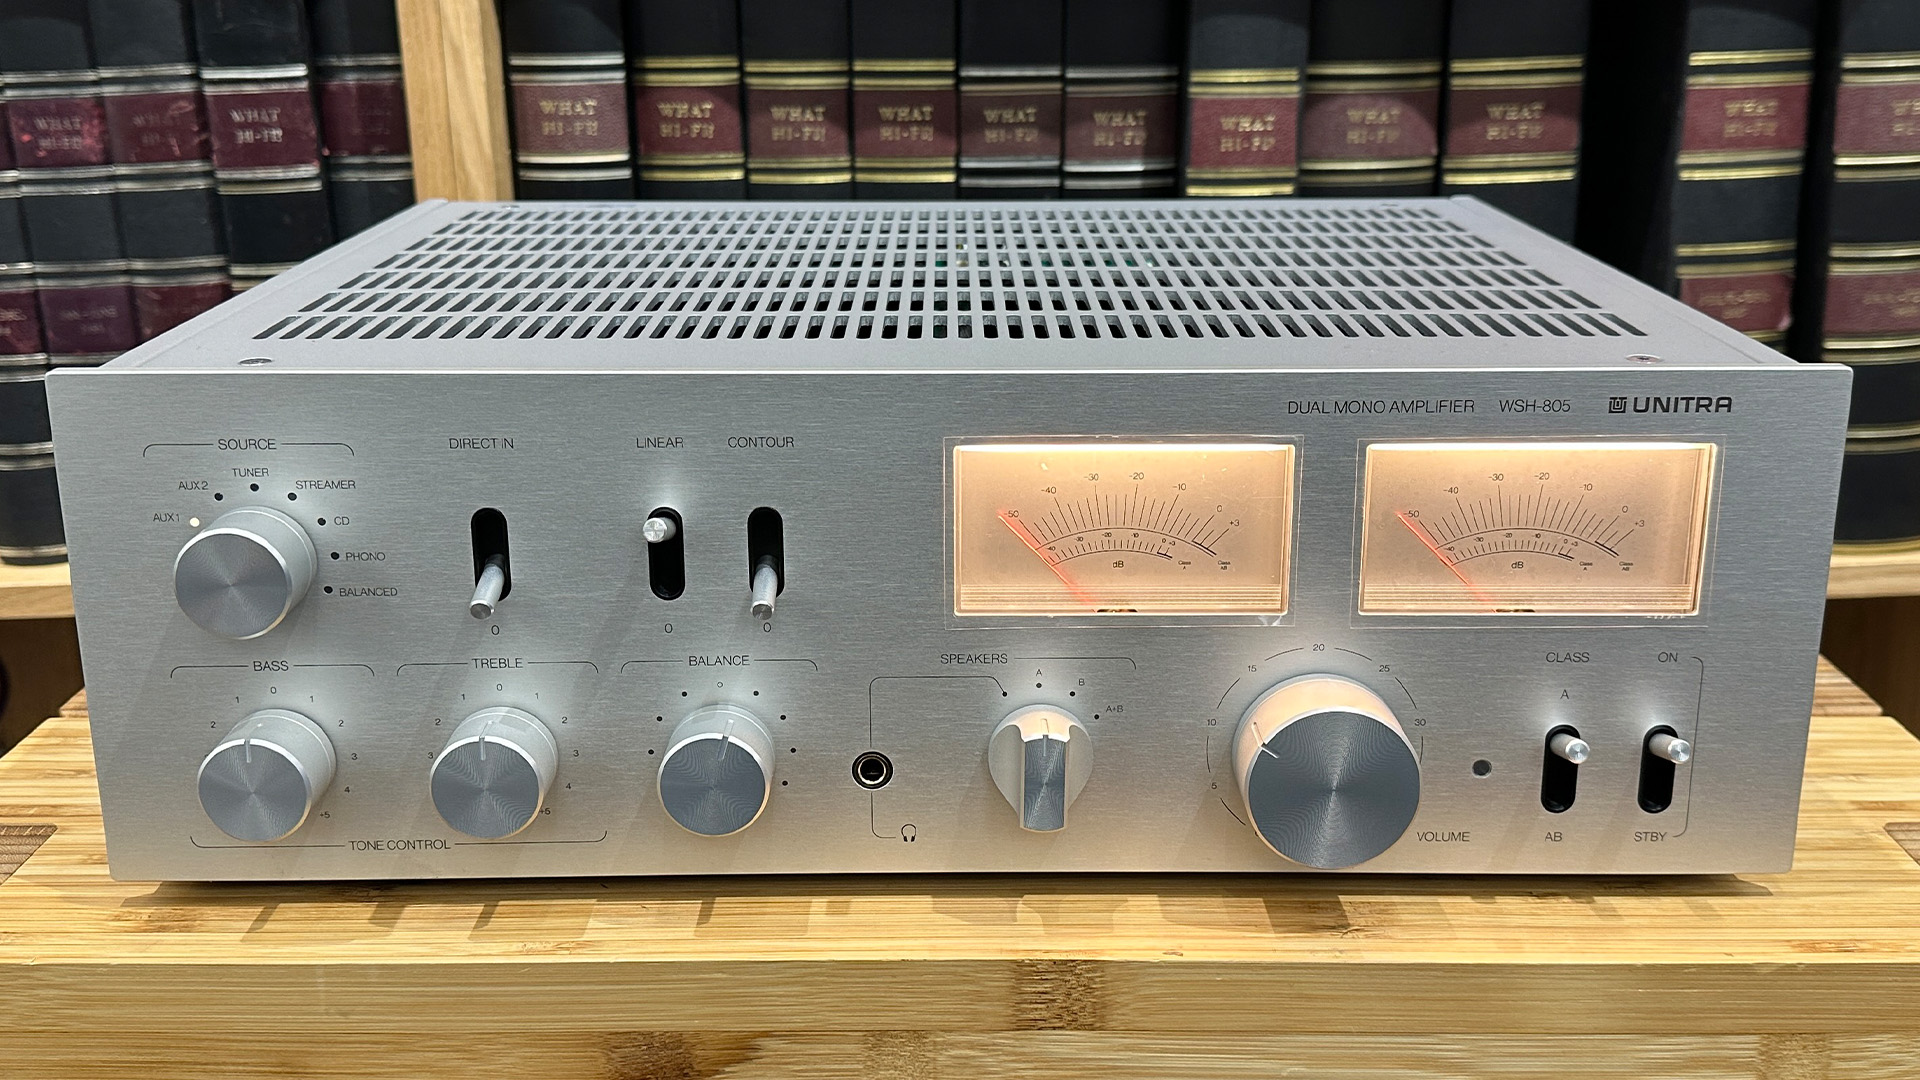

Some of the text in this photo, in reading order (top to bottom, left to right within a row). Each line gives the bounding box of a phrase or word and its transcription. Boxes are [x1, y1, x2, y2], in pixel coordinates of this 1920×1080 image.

[1288, 399, 1475, 415] DUAL MONO AMPLIFIER
[1499, 398, 1571, 413] WSH-805
[1632, 396, 1733, 414] UNITRA
[217, 438, 278, 451] SOURCE
[449, 437, 515, 450] DIRECT IN
[636, 437, 684, 450] LINEAR
[727, 436, 795, 450] CONTOUR
[232, 467, 270, 479] TUNER
[1084, 473, 1099, 482] -30
[1128, 472, 1145, 482] -20
[1487, 472, 1505, 483] -30
[1533, 471, 1550, 482] -20
[295, 480, 357, 491] STREAMER
[1172, 482, 1188, 493] -10
[1442, 485, 1460, 496] -40
[1578, 482, 1594, 493] -10
[1040, 486, 1058, 496] -40
[1003, 509, 1020, 518] -50
[1215, 504, 1223, 514] 0
[1402, 508, 1421, 519] -50
[1621, 505, 1629, 514] 0
[333, 516, 351, 527] CD
[1229, 518, 1240, 529] +3
[1634, 519, 1646, 529] +3
[345, 552, 386, 562] PHONO
[1112, 560, 1125, 569] dB
[1511, 561, 1525, 569] dB
[339, 587, 398, 598] BALANCED
[1312, 643, 1325, 652] 20
[688, 655, 750, 667] BALANCE
[940, 653, 1008, 665] SPEAKERS
[1545, 651, 1590, 663] CLASS
[1657, 651, 1678, 663] ON
[253, 660, 289, 672] BASS
[472, 658, 523, 669] TREBLE
[1247, 664, 1257, 673] 15
[1378, 664, 1391, 673] 25
[1035, 668, 1043, 677] A
[1078, 678, 1086, 687] B
[461, 693, 466, 701] 1
[1560, 689, 1570, 700] A
[235, 696, 240, 704] 1
[1105, 705, 1124, 713] A+B
[210, 721, 217, 729] 2
[338, 719, 345, 727] 2
[434, 718, 442, 726] 2
[561, 716, 569, 724] 2
[1206, 718, 1217, 727] 10
[1414, 718, 1427, 727] 30
[351, 752, 359, 760] 3
[427, 751, 434, 759] 3
[572, 749, 580, 757] 3
[565, 782, 573, 790] 4
[1211, 782, 1218, 790] 5
[319, 811, 331, 819] +5
[1416, 831, 1471, 843] VOLUME
[1544, 831, 1563, 842] AB
[1633, 831, 1668, 842] STBY
[348, 839, 452, 851] TONE CONTROL
